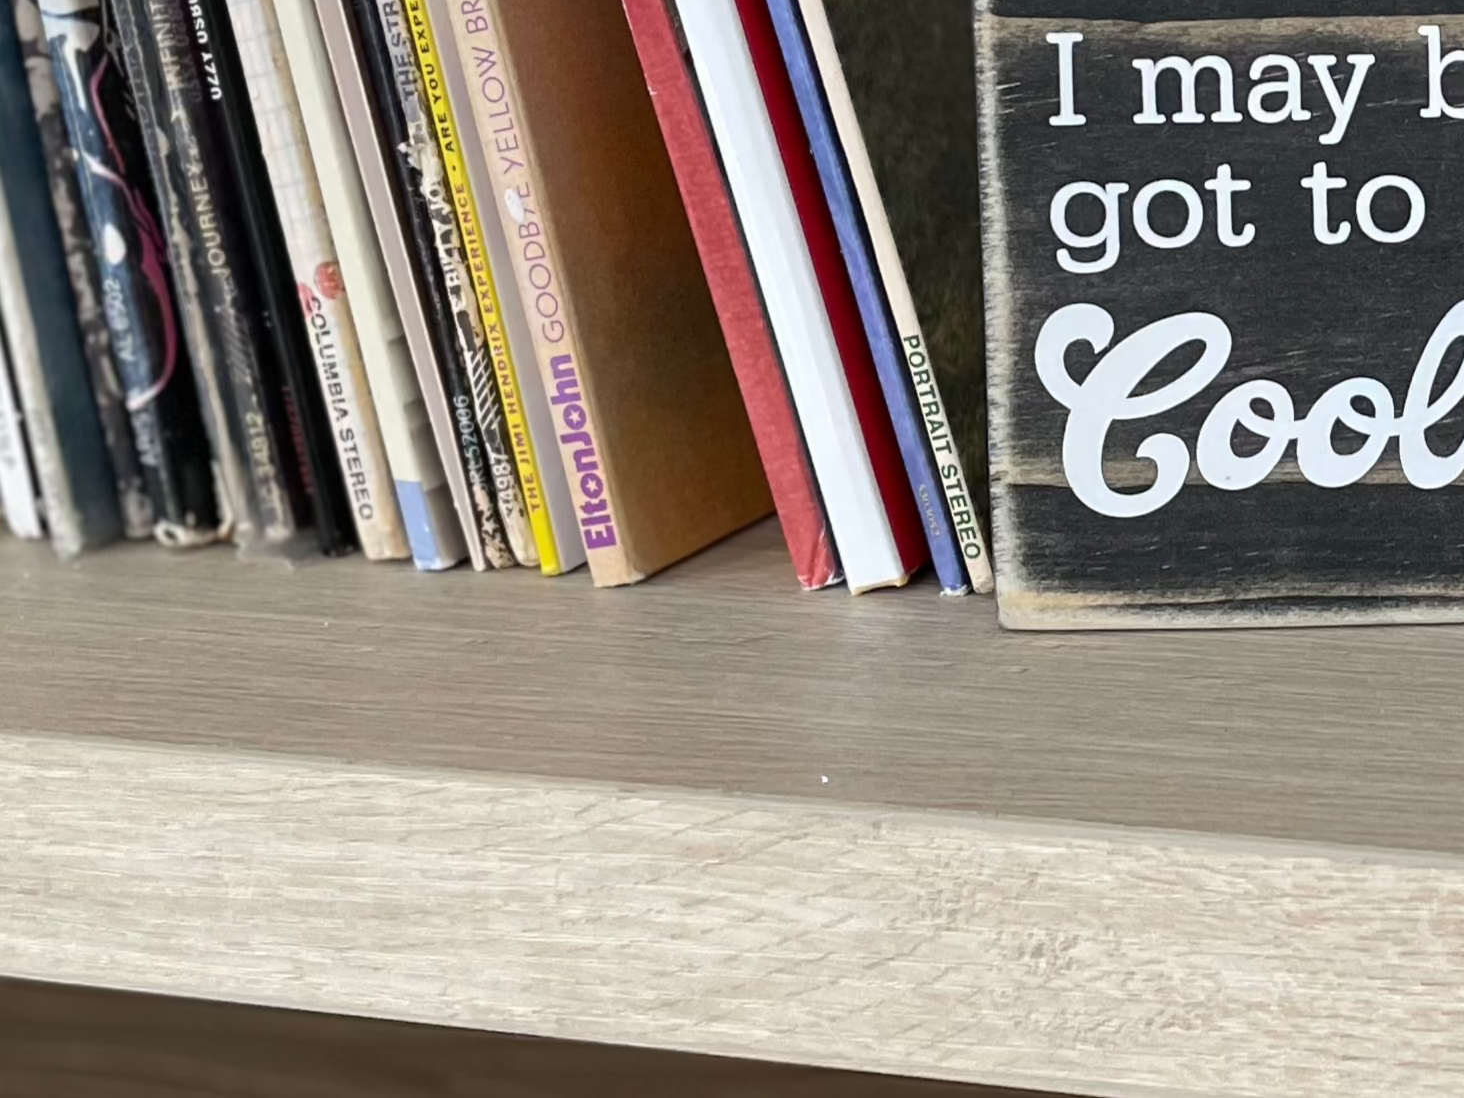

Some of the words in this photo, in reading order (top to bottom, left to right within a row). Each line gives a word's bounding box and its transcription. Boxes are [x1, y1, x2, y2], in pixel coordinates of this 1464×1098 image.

[425, 63, 443, 105] YOU
[437, 112, 456, 152] ARE
[474, 46, 524, 174] YELLOW
[1046, 32, 1087, 126] I
[1132, 53, 1376, 145] may
[190, 164, 228, 276] JOURNEY
[456, 184, 494, 314] EXPERIENCE
[1050, 163, 1256, 274] got
[1301, 161, 1426, 245] to
[309, 297, 349, 422] COLUMBIA
[338, 428, 374, 521] STEREO
[489, 323, 517, 415] HENDRIX
[512, 423, 530, 465] JIMI
[524, 472, 541, 511] THE
[903, 333, 954, 457] PORTRAIT
[940, 461, 982, 561] STEREO
